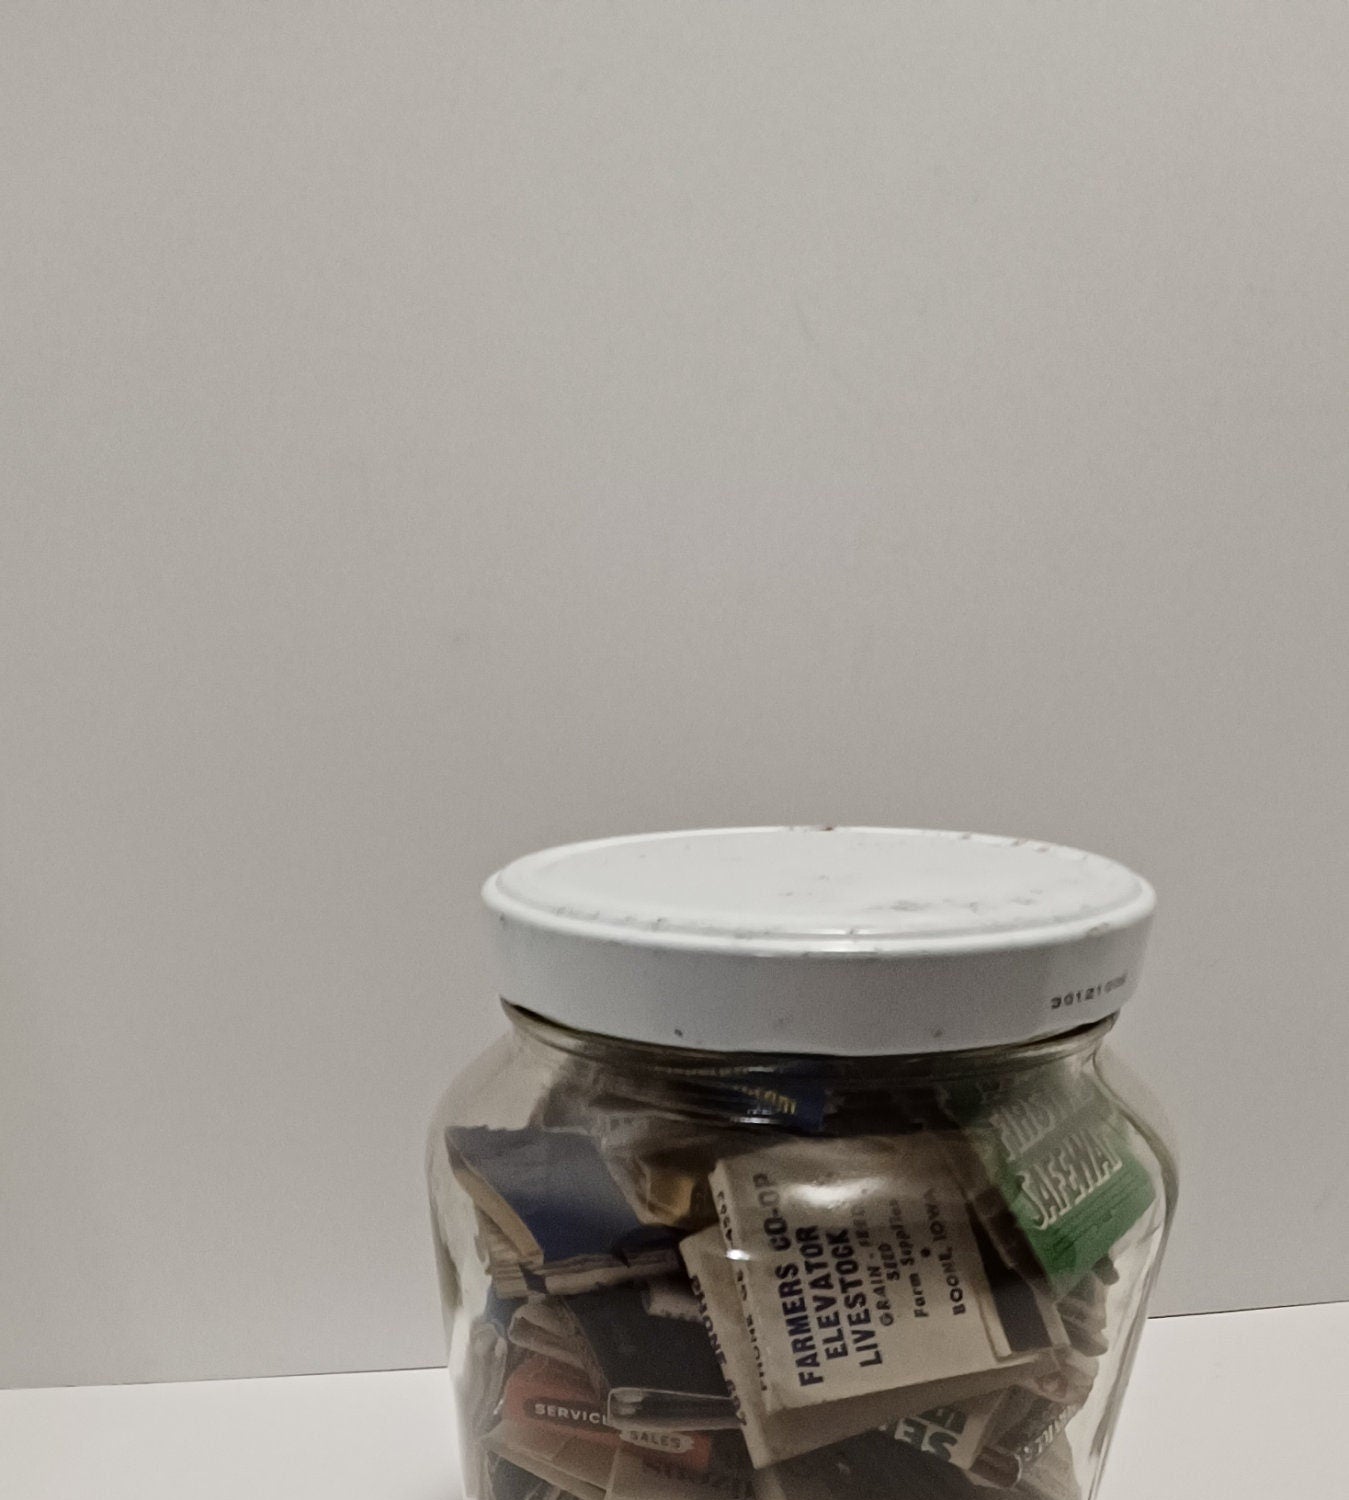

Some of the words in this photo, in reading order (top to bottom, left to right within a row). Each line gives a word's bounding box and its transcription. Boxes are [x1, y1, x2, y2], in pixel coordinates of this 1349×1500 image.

[753, 1173, 791, 1250] CO-OP
[1016, 1128, 1123, 1231] SAFEWAY
[796, 1225, 848, 1360] ELEVATOR
[826, 1229, 882, 1367] LIVESTOCK
[867, 1265, 894, 1326] GRAIN
[878, 1243, 900, 1280] SEED
[909, 1273, 929, 1317] Farm
[775, 1263, 823, 1386] FARMERS
[629, 1430, 681, 1449] SALES
